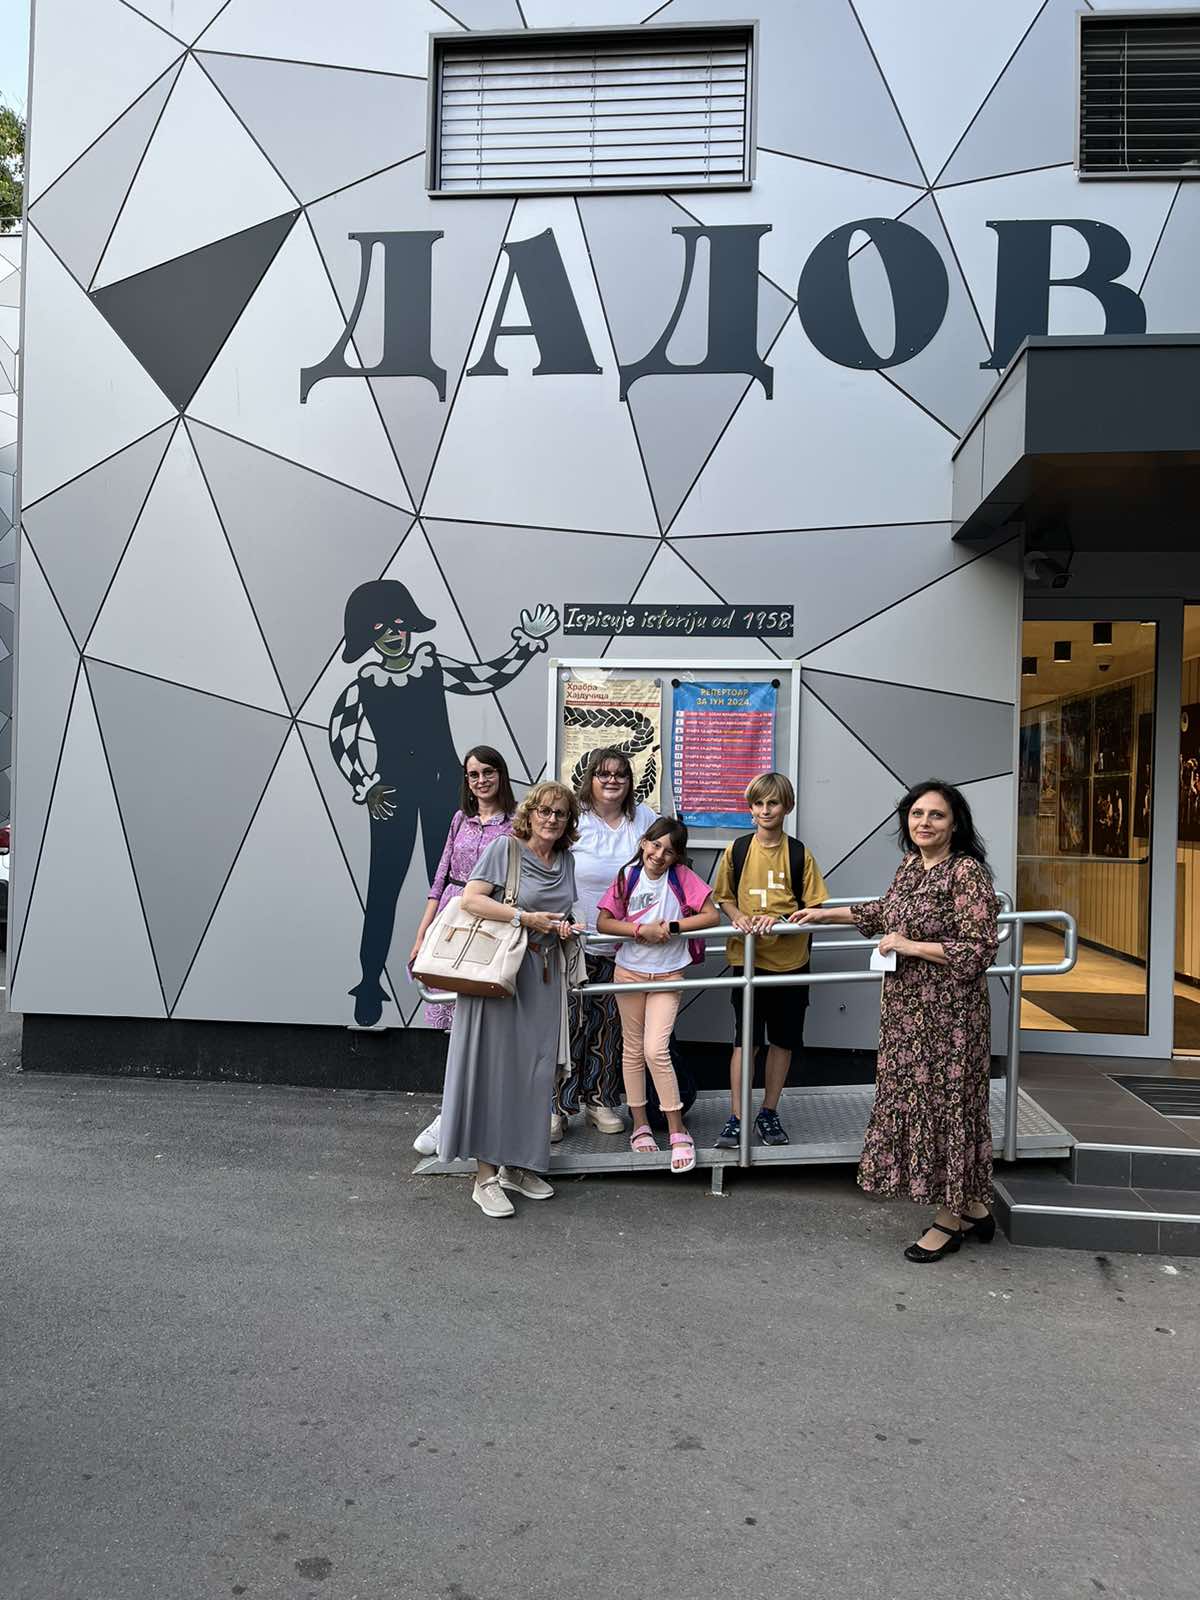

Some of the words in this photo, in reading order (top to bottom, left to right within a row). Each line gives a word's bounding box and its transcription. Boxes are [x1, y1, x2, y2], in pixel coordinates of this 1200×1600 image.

[300, 217, 1147, 404] ДАДОВ
[564, 608, 636, 633] Ispisuje
[641, 609, 706, 634] istoriju
[712, 609, 736, 629] od
[567, 682, 598, 692] Храбра
[700, 687, 749, 697] РЕПЕРТОАР
[696, 697, 707, 706] ЗА
